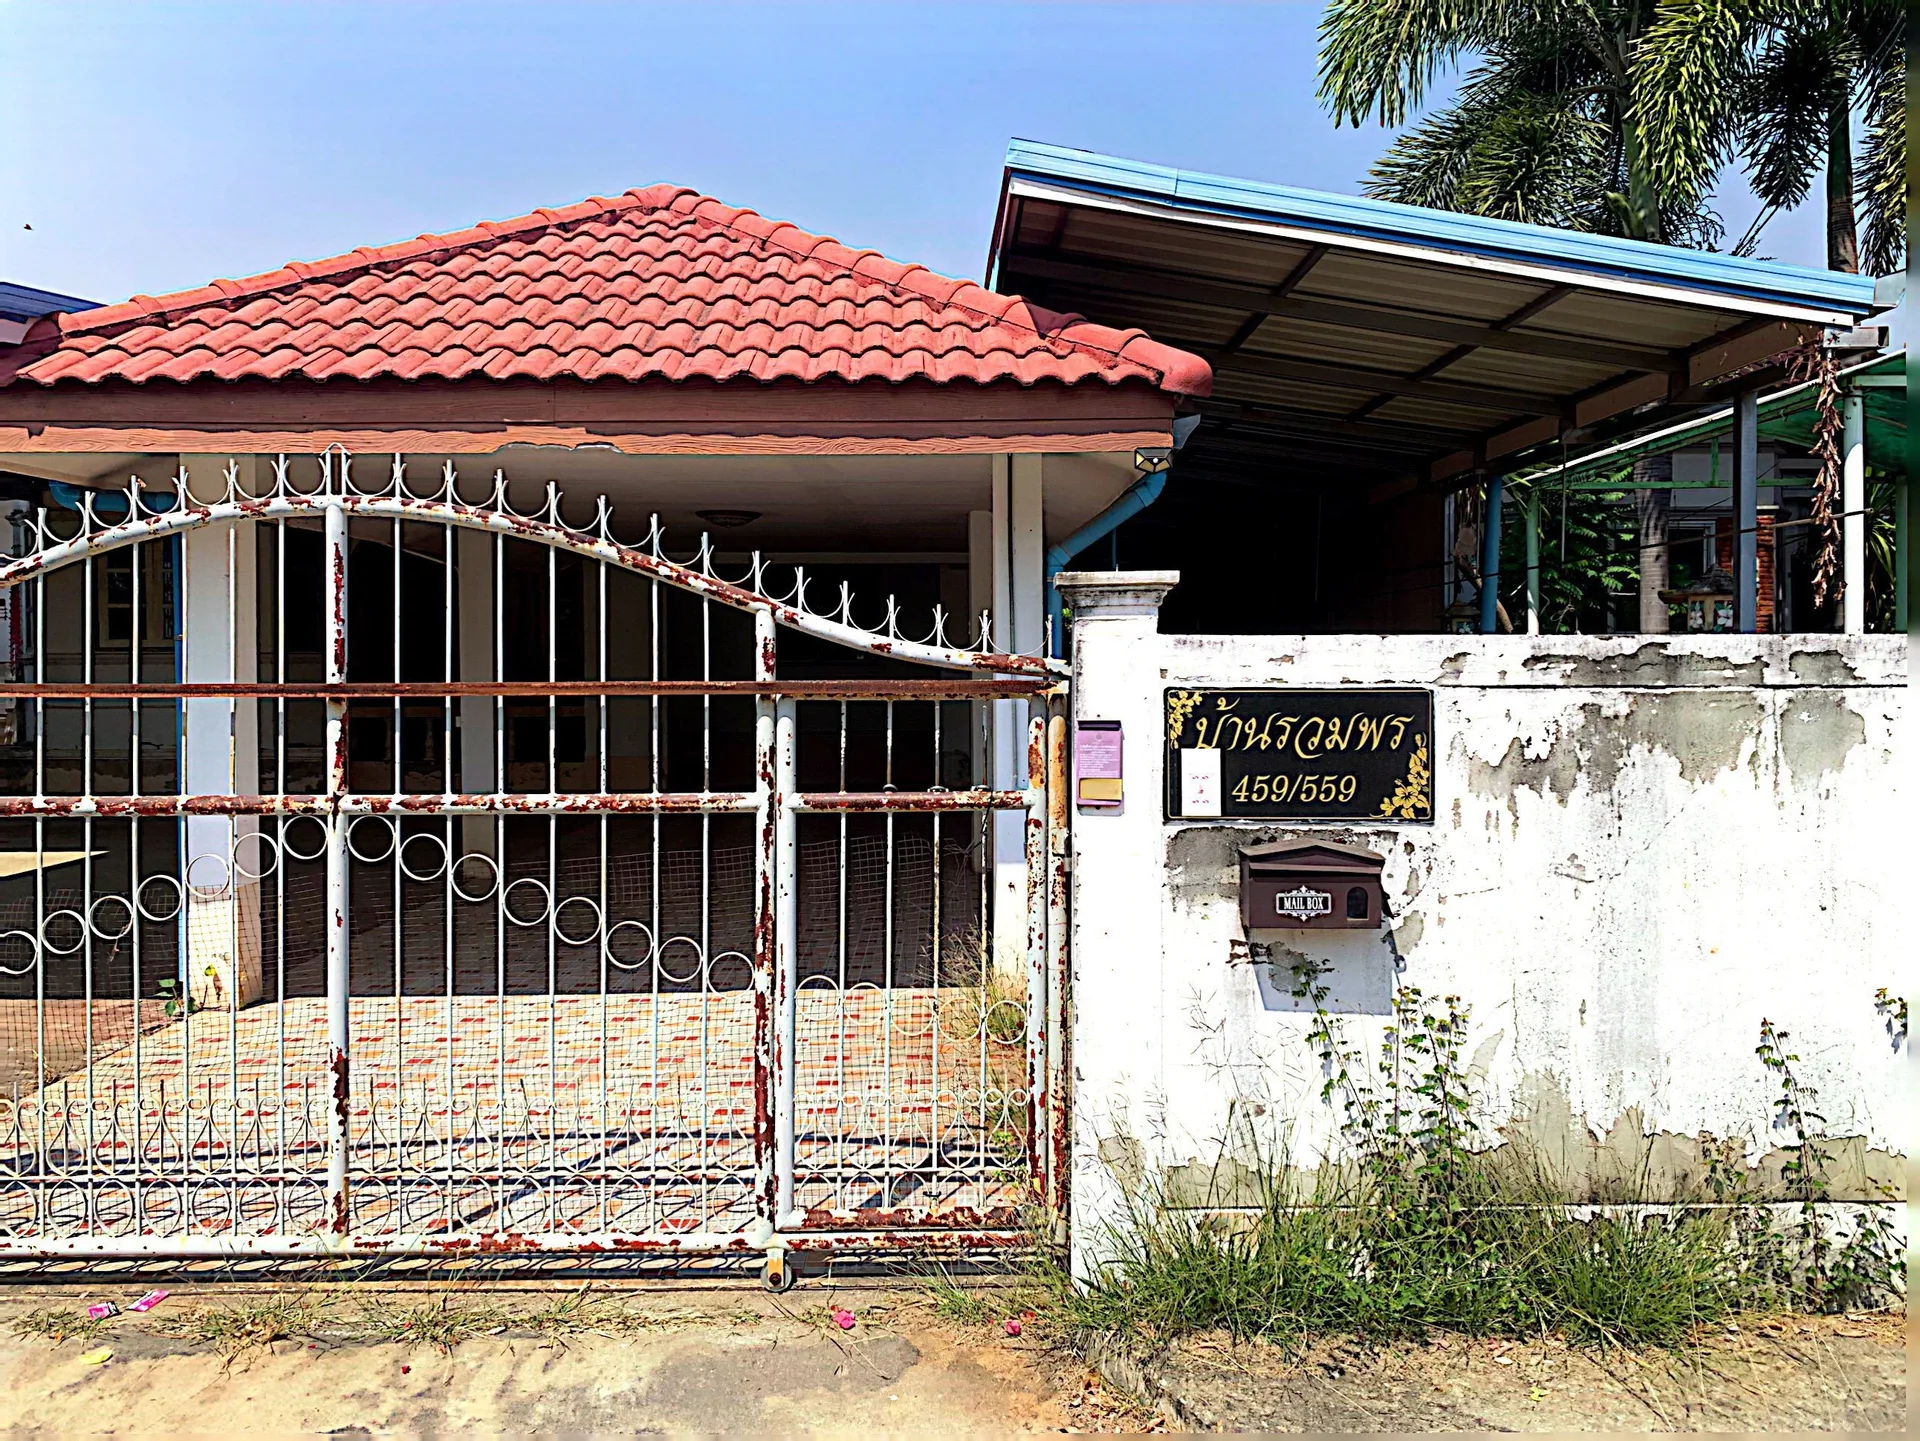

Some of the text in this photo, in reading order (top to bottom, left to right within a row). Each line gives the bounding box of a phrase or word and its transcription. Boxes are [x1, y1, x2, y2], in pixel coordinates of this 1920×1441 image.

[1195, 696, 1415, 759] บ้านรวมพร
[1231, 774, 1357, 803] 459/559
[1283, 897, 1324, 910] MAIL BOX
